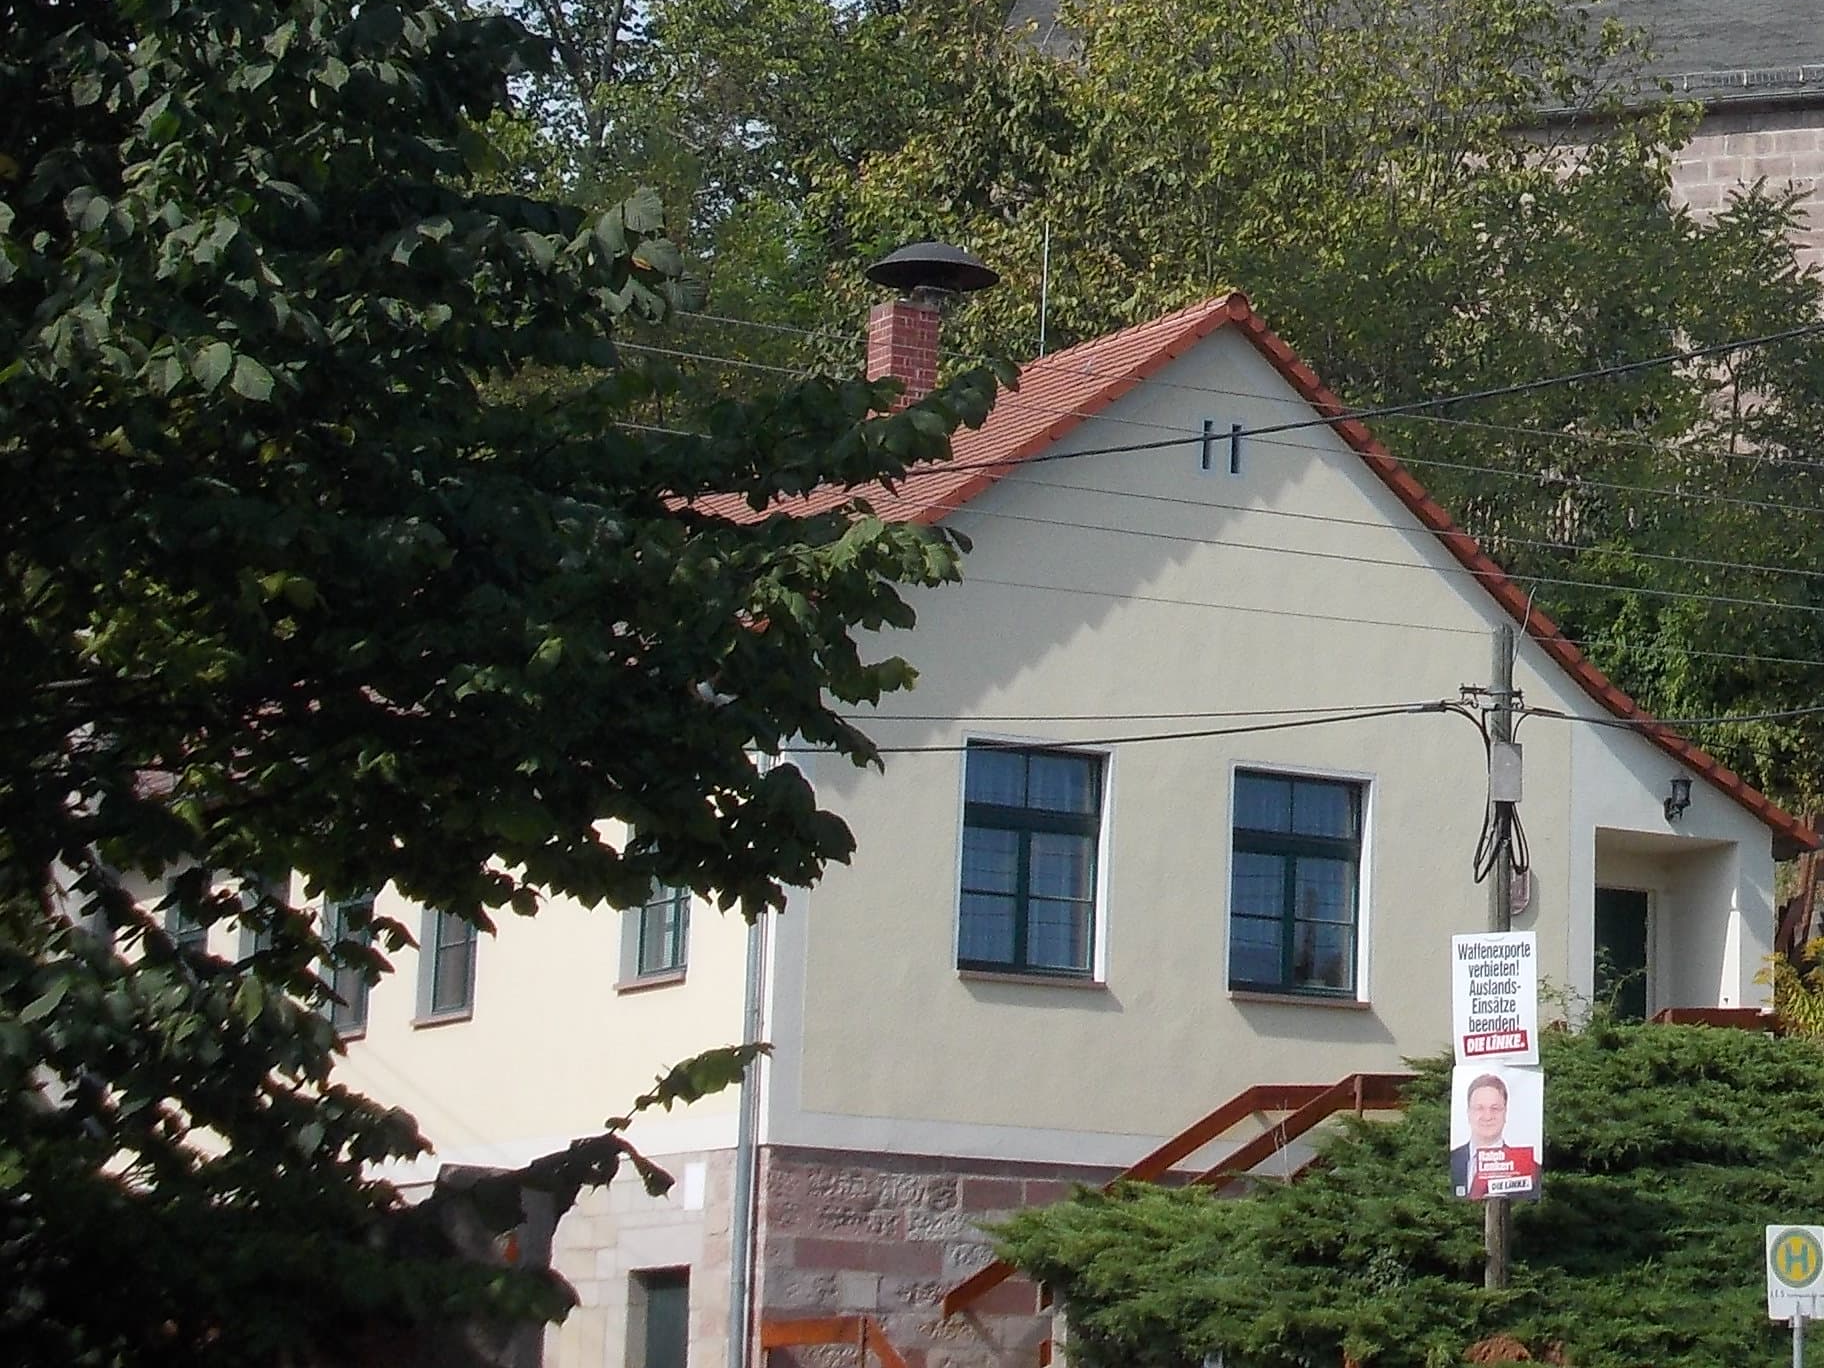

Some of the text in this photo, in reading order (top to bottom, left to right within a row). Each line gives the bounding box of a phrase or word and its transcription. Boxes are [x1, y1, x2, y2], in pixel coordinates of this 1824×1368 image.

[1458, 942, 1531, 960] Waffenexporte
[1468, 960, 1519, 977] verbieten!
[1469, 978, 1521, 996] Auslands-
[1472, 996, 1517, 1014] Einsätze
[1468, 1014, 1520, 1032] beenden!
[1466, 1036, 1485, 1053] DIE
[1785, 1240, 1809, 1273] H
